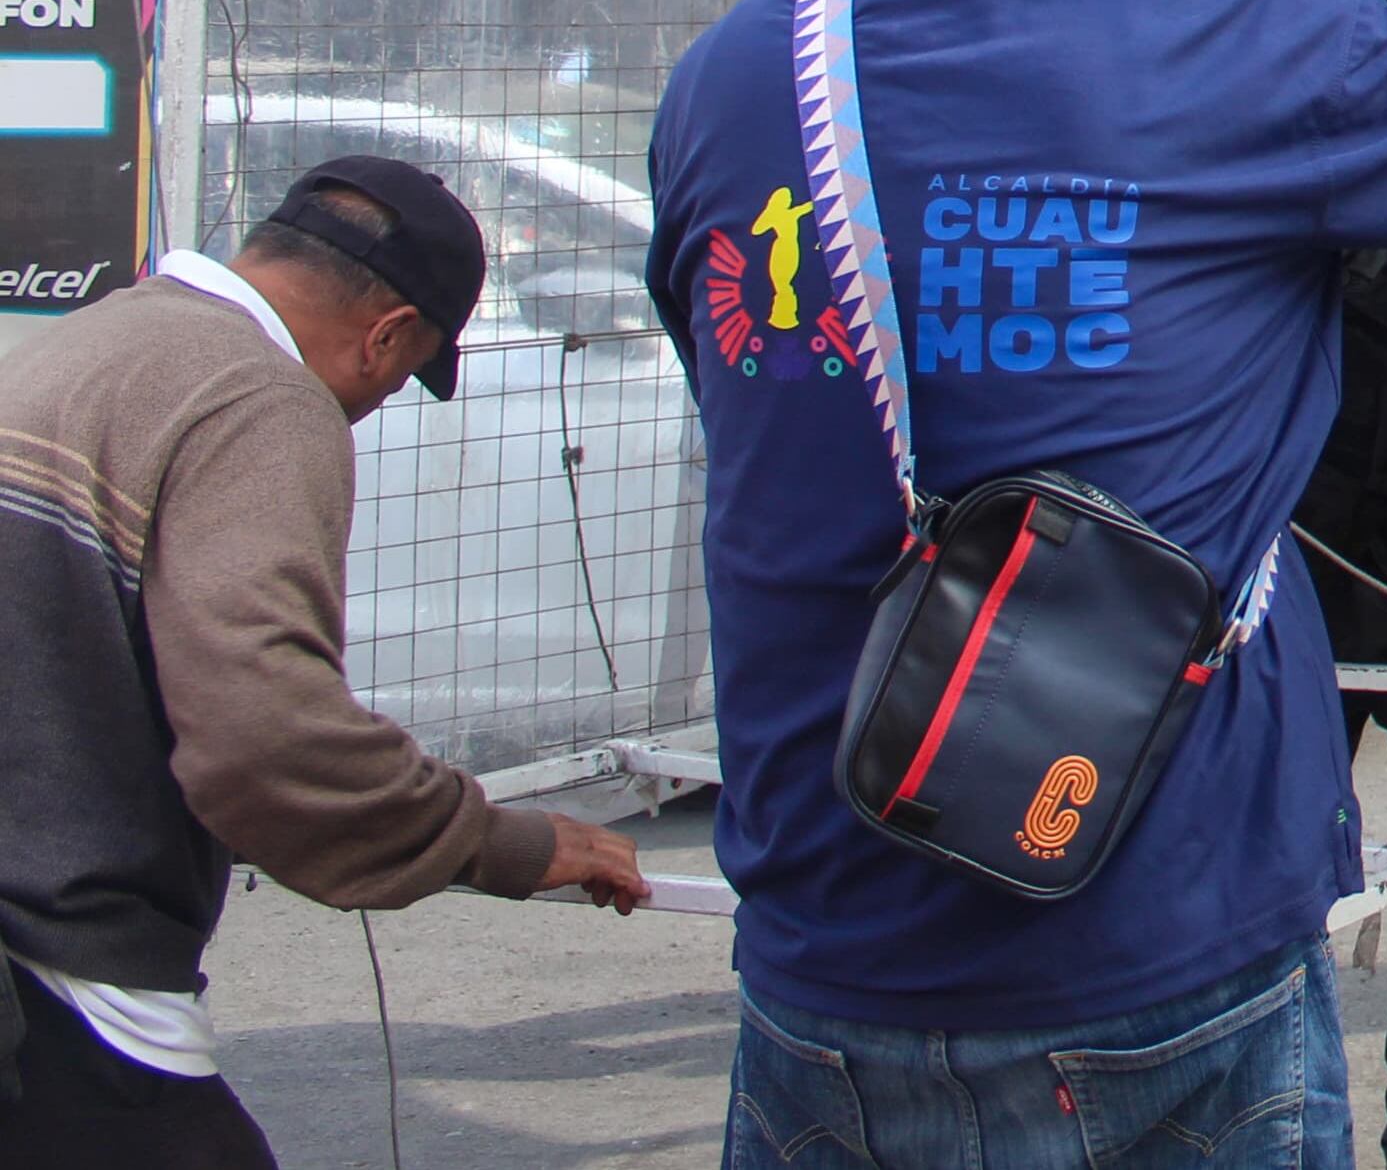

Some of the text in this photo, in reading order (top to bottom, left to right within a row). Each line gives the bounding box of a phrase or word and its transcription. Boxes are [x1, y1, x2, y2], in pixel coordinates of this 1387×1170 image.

[923, 196, 1139, 244] CUAU
[0, 261, 106, 299] elcel
[919, 247, 1130, 307] HTE
[916, 311, 1131, 374] MOC
[1014, 830, 1066, 860] COACH
